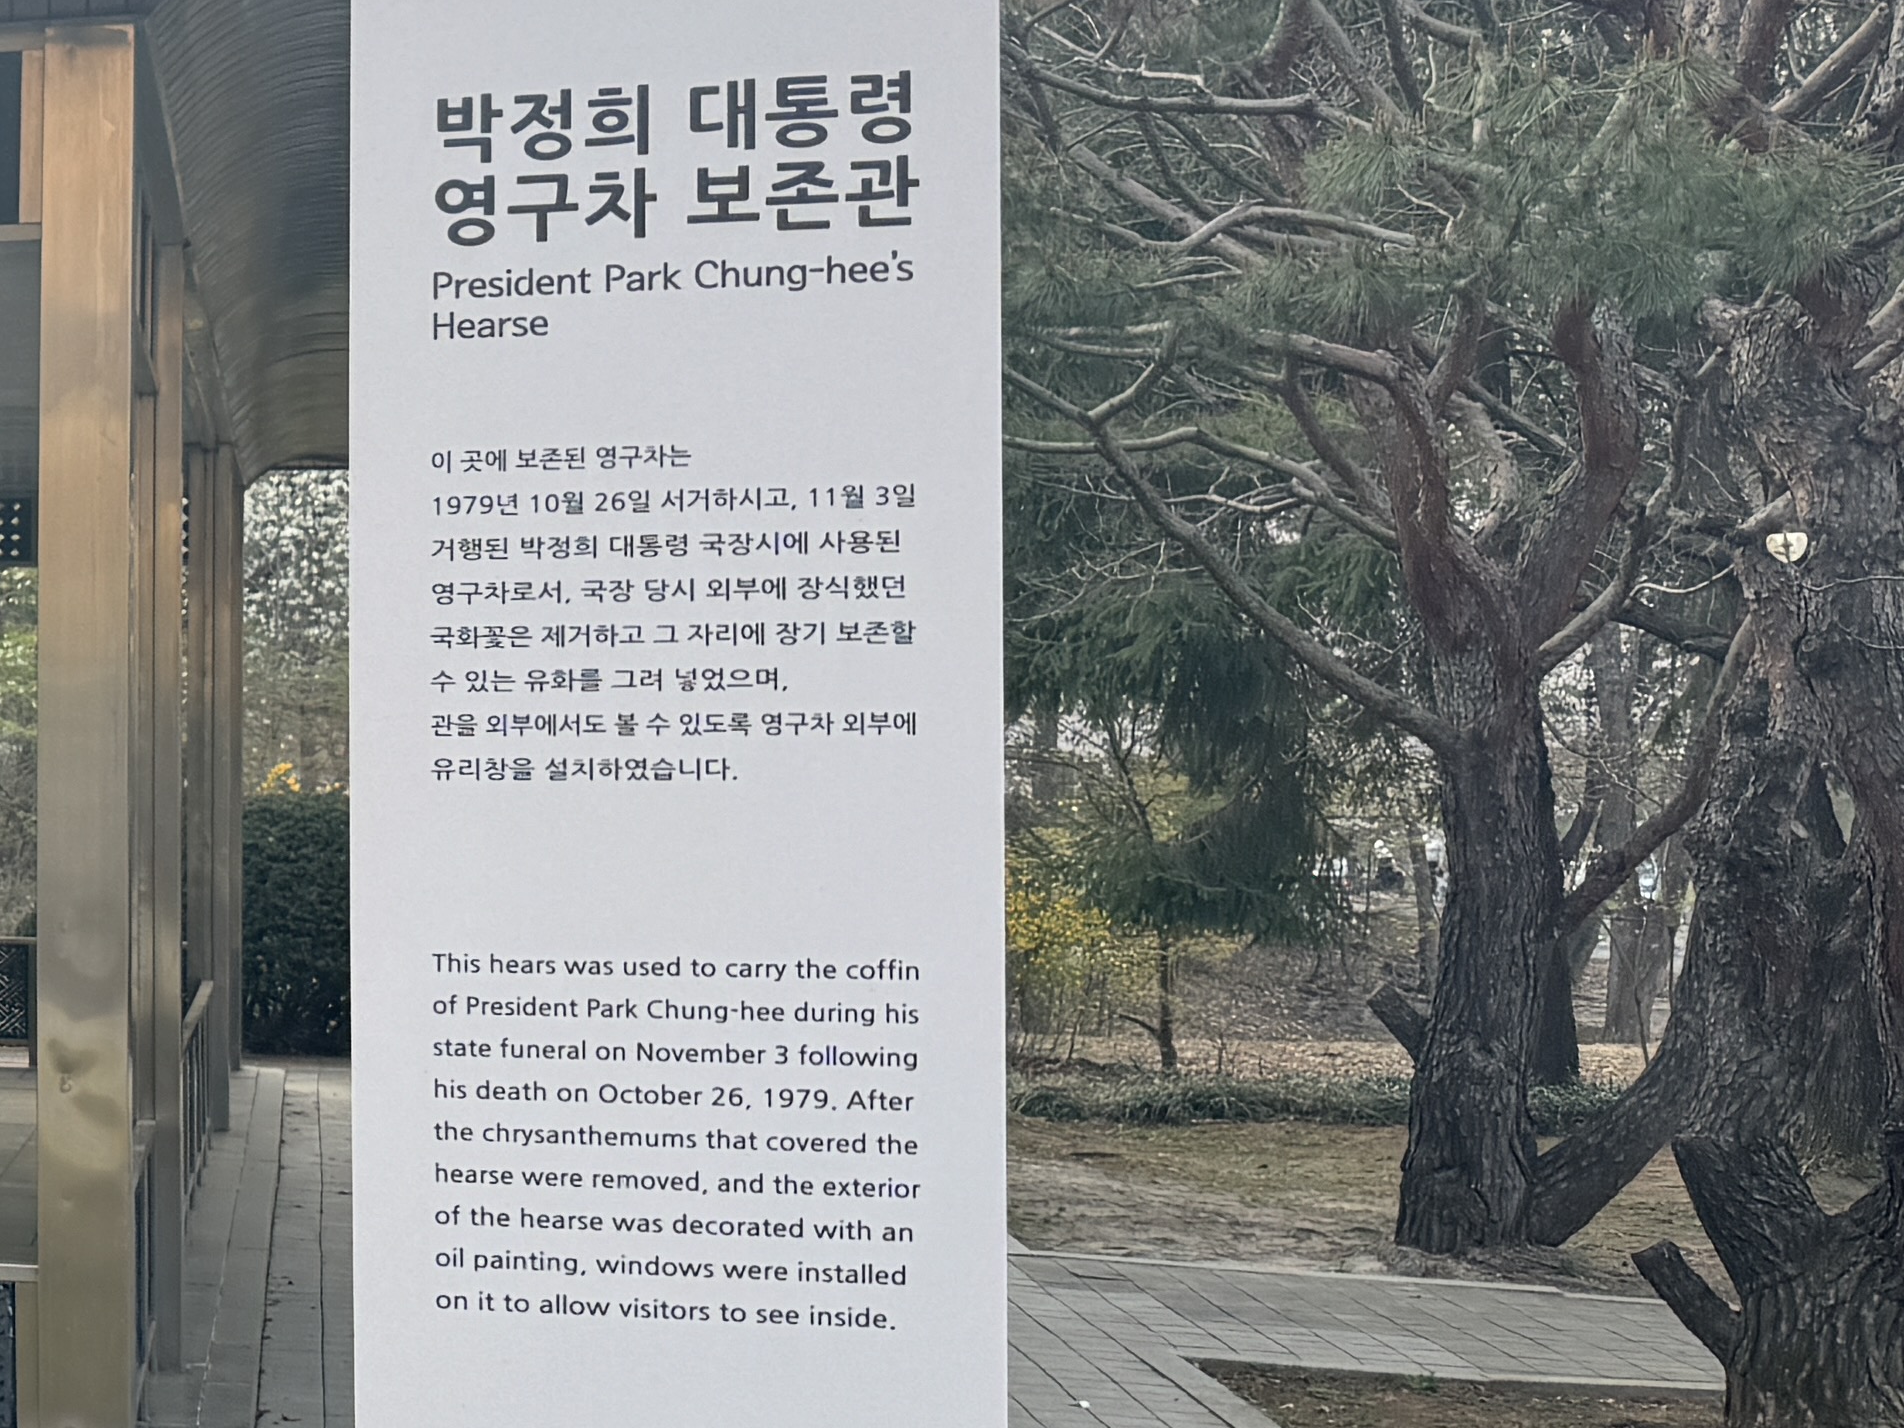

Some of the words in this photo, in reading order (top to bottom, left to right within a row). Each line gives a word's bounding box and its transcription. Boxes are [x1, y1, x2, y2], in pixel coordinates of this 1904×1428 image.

[436, 83, 650, 164] 박정희
[689, 69, 912, 151] 대통령
[434, 166, 658, 247] 영구차
[686, 154, 921, 232] 보존관
[432, 267, 592, 301] President
[605, 261, 682, 293] Park
[694, 249, 914, 292] Chung-hee's
[432, 311, 549, 341] Hearse
[431, 449, 452, 474] 이
[459, 448, 507, 473] 곳에
[514, 446, 586, 471] 보존된
[595, 444, 692, 470] 영구차는
[433, 492, 519, 516] 1979년
[530, 490, 584, 516] 10월
[594, 489, 651, 514] 26일
[660, 486, 797, 513] 서거하시고,
[809, 484, 864, 510] 11월
[875, 482, 916, 508] 3일
[431, 536, 509, 562] 거행된
[520, 534, 598, 561] 박정희
[609, 533, 688, 559] 대통령
[698, 530, 809, 557] 국장시에
[818, 529, 901, 555] 사용된
[431, 579, 571, 606] 영구차로서,
[580, 578, 635, 604] 국장
[644, 577, 695, 603] 당시
[705, 575, 787, 602] 외부에
[797, 574, 906, 601] 장식했던
[429, 625, 533, 650] 국화꽃은
[540, 623, 646, 649] 제거하고
[652, 624, 679, 644] 그
[687, 621, 765, 647] 자리에
[775, 621, 826, 646] 장기
[836, 619, 917, 645] 보존할
[430, 669, 457, 694] 수
[464, 669, 517, 693] 있는
[523, 668, 603, 693] 유화를
[610, 667, 663, 693] 그려
[675, 666, 788, 693] 넣었으며,
[430, 713, 479, 737] 관을
[485, 713, 607, 738] 외부에서도
[613, 712, 639, 737] 볼
[645, 712, 671, 737] 수
[679, 712, 753, 737] 있도록
[760, 711, 835, 737] 영구차
[842, 711, 917, 737] 외부에
[430, 757, 536, 782] 유리창을
[544, 756, 738, 782] 설치하였습니다.
[431, 952, 481, 974] This
[489, 952, 556, 975] hears
[563, 960, 614, 976] was
[623, 955, 681, 977] used
[690, 958, 717, 978] to
[725, 962, 788, 982] carry
[794, 957, 837, 980] the
[845, 958, 920, 981] coffin
[432, 993, 458, 1015] of
[466, 995, 579, 1018] President
[587, 997, 638, 1019] Park
[646, 998, 785, 1024] Chung-hee
[793, 1000, 875, 1027] during
[885, 1002, 920, 1025] his
[433, 1038, 492, 1058] state
[499, 1036, 586, 1061] funeral
[595, 1045, 626, 1062] on
[636, 1041, 767, 1065] November
[774, 1044, 789, 1065] 3
[797, 1043, 918, 1072] following
[434, 1077, 467, 1100] his
[475, 1079, 547, 1102] death
[556, 1087, 588, 1103] on
[598, 1083, 703, 1106] October
[711, 1086, 752, 1111] 26,
[764, 1087, 837, 1112] 1979.
[846, 1088, 915, 1112] After
[433, 1120, 474, 1142] the
[482, 1121, 697, 1149] chrysanthemums
[705, 1128, 758, 1151] that
[765, 1132, 867, 1154] covered
[876, 1133, 919, 1156] the
[434, 1161, 514, 1186] hearse
[521, 1171, 584, 1188] were
[592, 1170, 708, 1196] removed,
[717, 1172, 764, 1194] and
[772, 1173, 814, 1196] the
[822, 1176, 921, 1200] exterior
[434, 1204, 461, 1226] of
[470, 1205, 511, 1228] the
[520, 1206, 604, 1232] hearse
[611, 1216, 664, 1234] was
[672, 1212, 804, 1239] decorated
[813, 1219, 872, 1242] with
[881, 1226, 914, 1243] an
[435, 1246, 464, 1269] oil
[473, 1249, 587, 1277] painting,
[595, 1254, 715, 1279] windows
[722, 1263, 788, 1282] were
[797, 1260, 907, 1286] installed
[435, 1294, 468, 1311] on
[478, 1290, 496, 1312] it
[503, 1294, 530, 1313] to
[539, 1293, 611, 1317] allow
[618, 1297, 711, 1322] visitors
[719, 1303, 747, 1323] to
[755, 1308, 800, 1326] see
[809, 1304, 896, 1331] inside.
